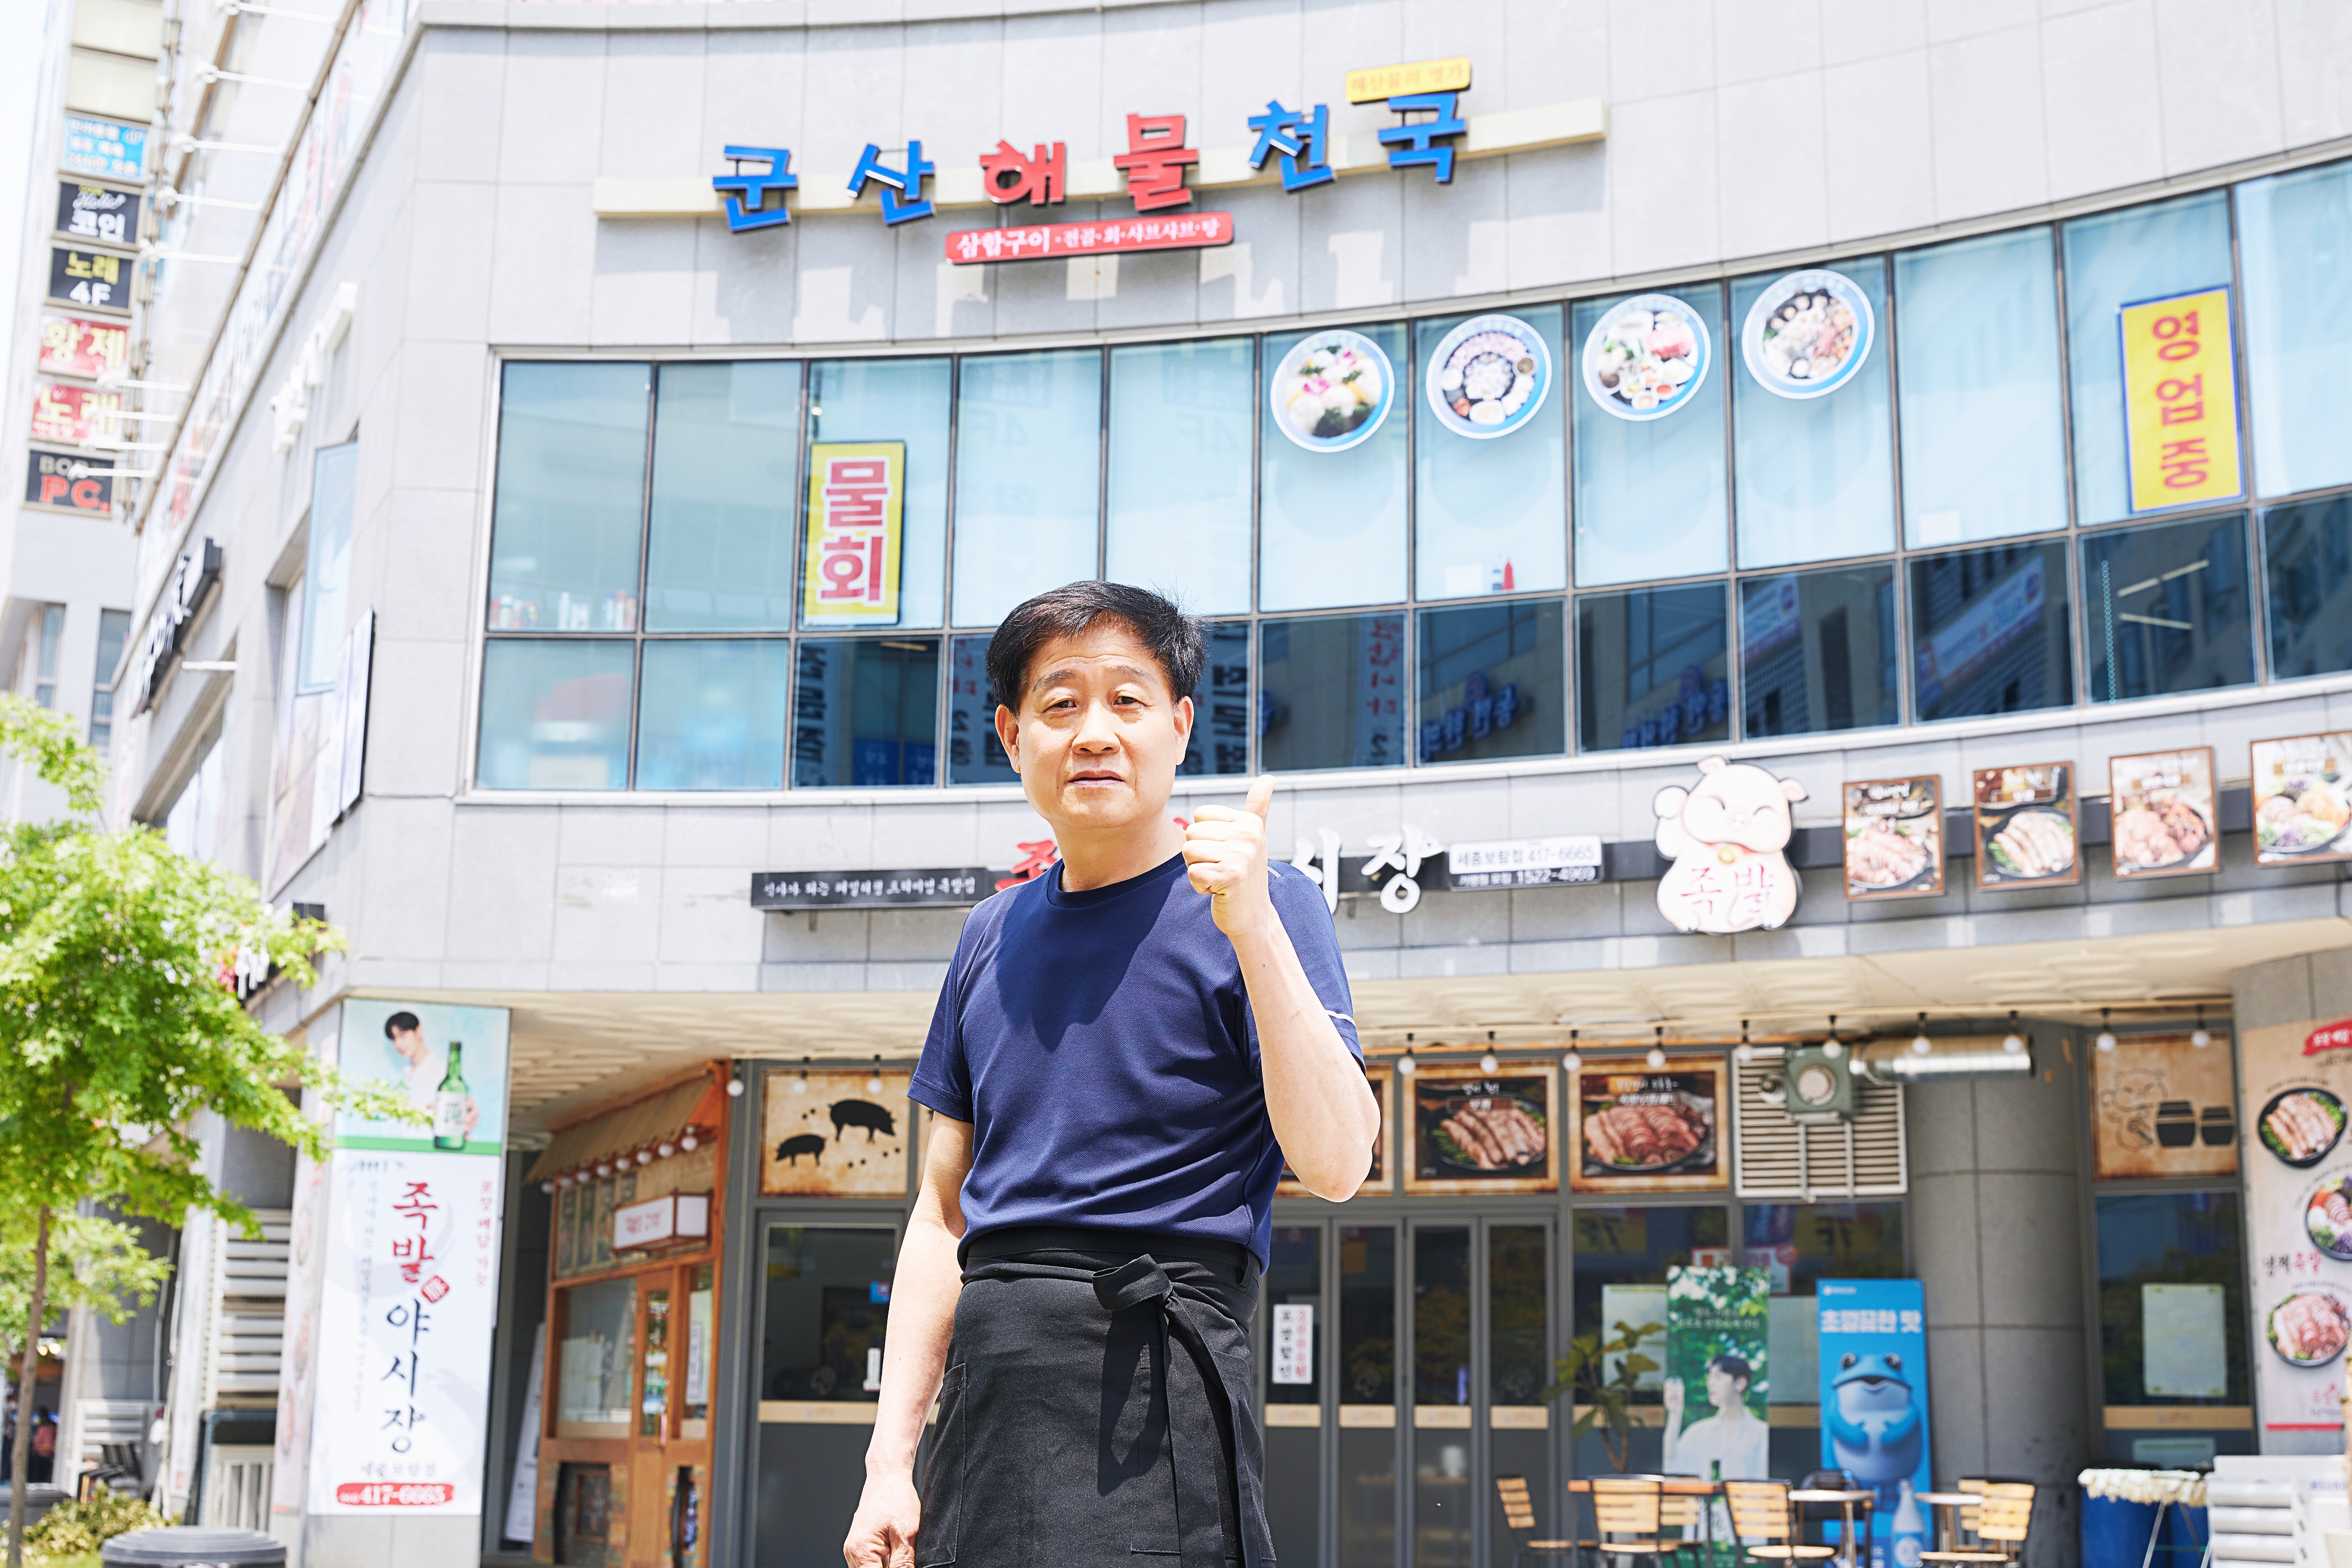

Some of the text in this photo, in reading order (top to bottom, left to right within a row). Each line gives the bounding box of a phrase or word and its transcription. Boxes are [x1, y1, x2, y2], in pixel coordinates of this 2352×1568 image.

[68, 209, 126, 243] 코인
[957, 227, 1051, 259] 삼합구이
[65, 251, 119, 285] 노래
[69, 280, 112, 307] 4F
[43, 322, 126, 369] 황제
[821, 460, 888, 601] 물회
[1528, 845, 1595, 862] 417-6665
[1681, 862, 1774, 915] 족발
[393, 1181, 438, 1283] 족발
[2293, 1250, 2321, 1275] 족발
[381, 1298, 430, 1453] 야시장
[360, 1484, 446, 1505] 417-6665
